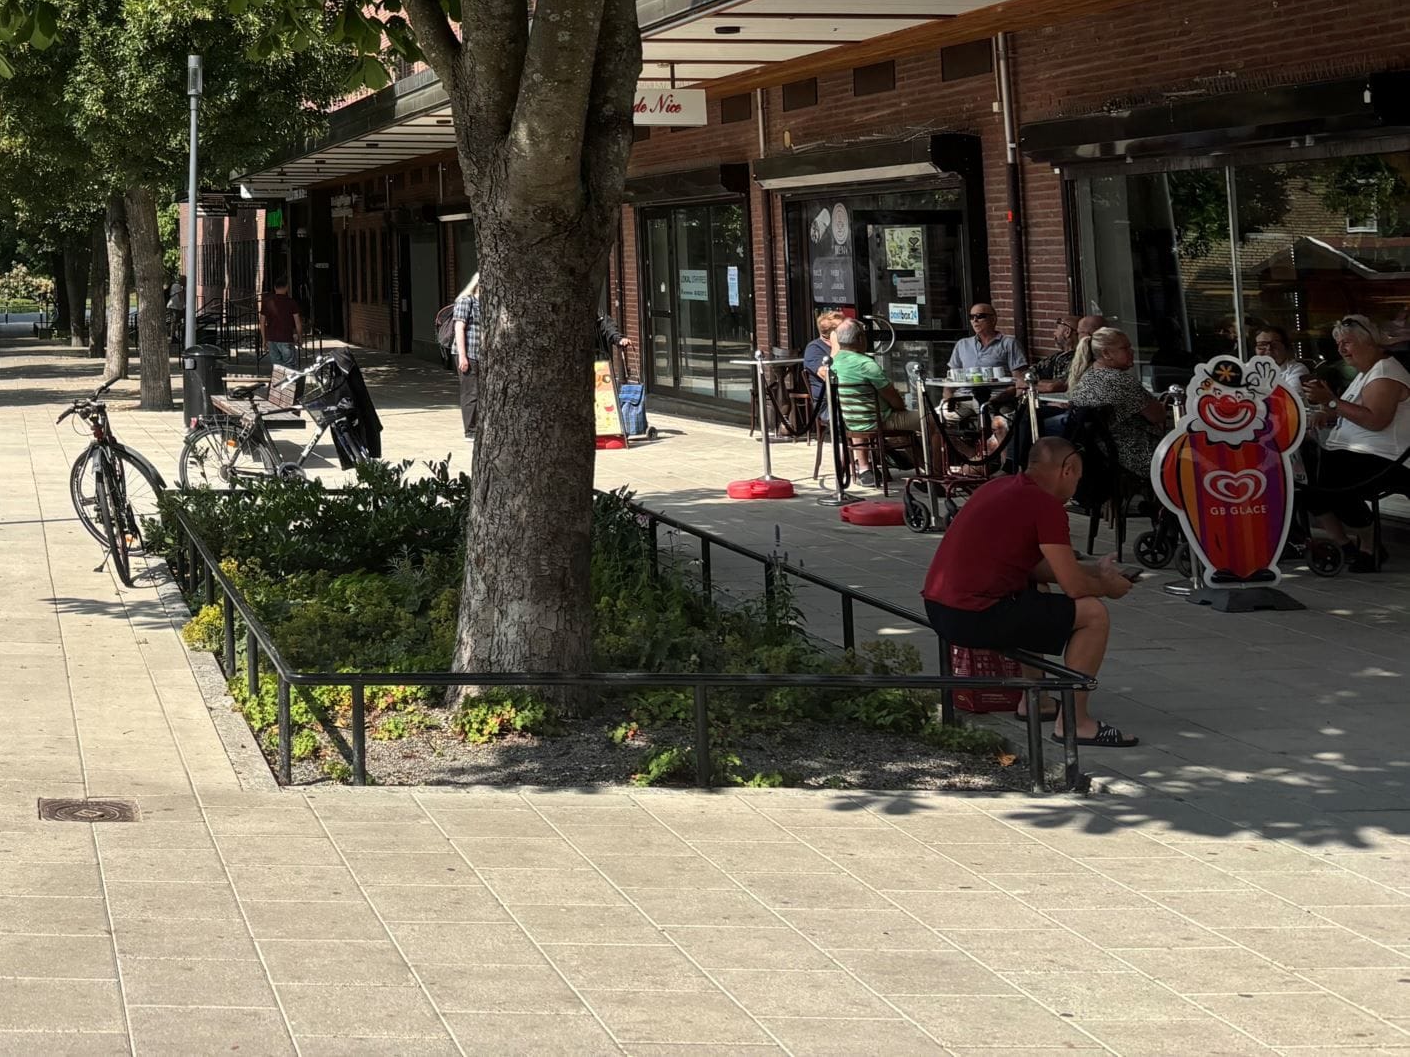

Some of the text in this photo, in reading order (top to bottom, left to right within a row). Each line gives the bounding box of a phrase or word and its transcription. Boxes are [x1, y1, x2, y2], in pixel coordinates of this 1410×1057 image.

[649, 93, 682, 114] Nice
[1210, 504, 1267, 516] GB GLACE
